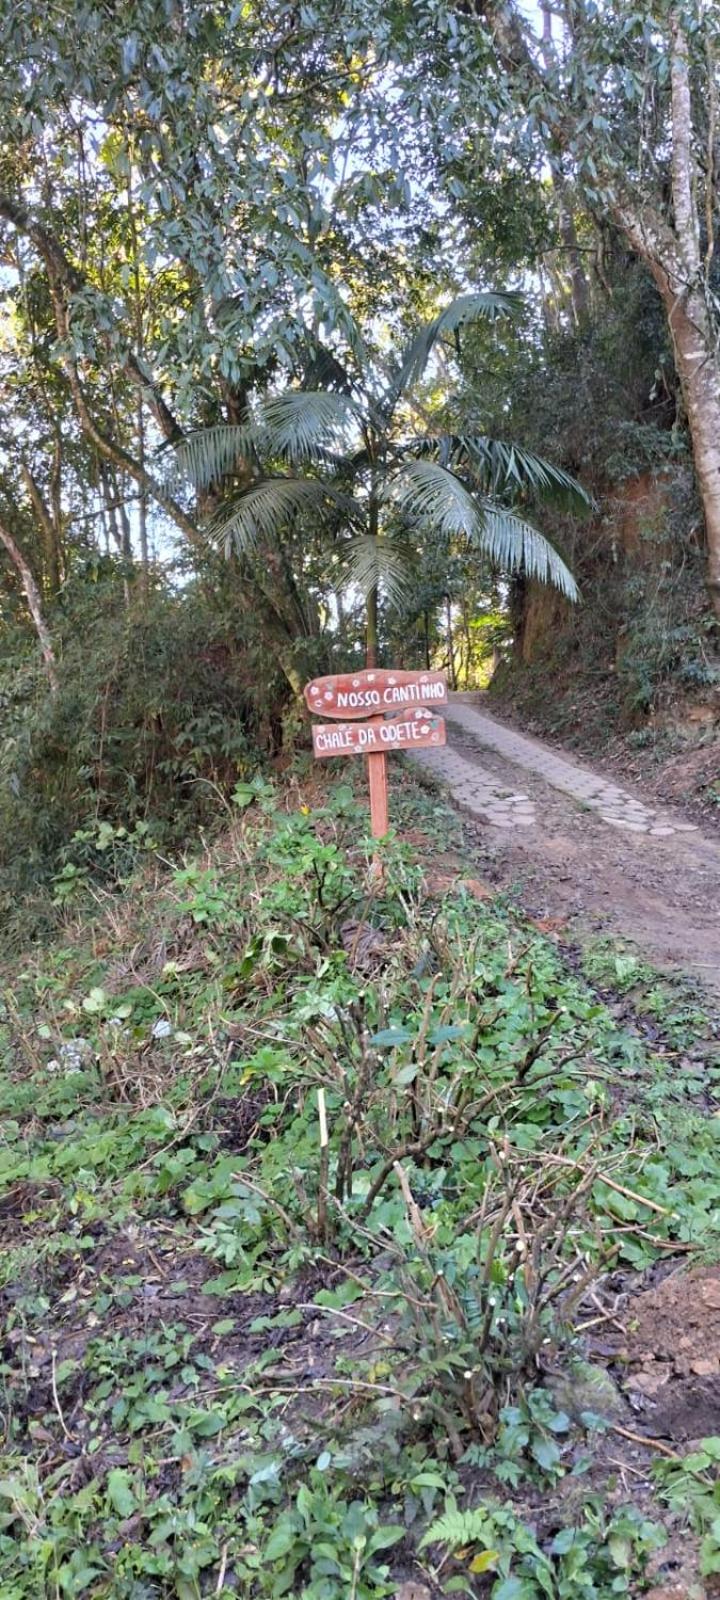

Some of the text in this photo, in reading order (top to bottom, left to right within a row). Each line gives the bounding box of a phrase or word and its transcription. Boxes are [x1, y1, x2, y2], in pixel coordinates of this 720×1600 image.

[337, 681, 445, 707] NOSSO CANTINHO
[358, 729, 376, 745] DA
[380, 721, 421, 743] ODETE
